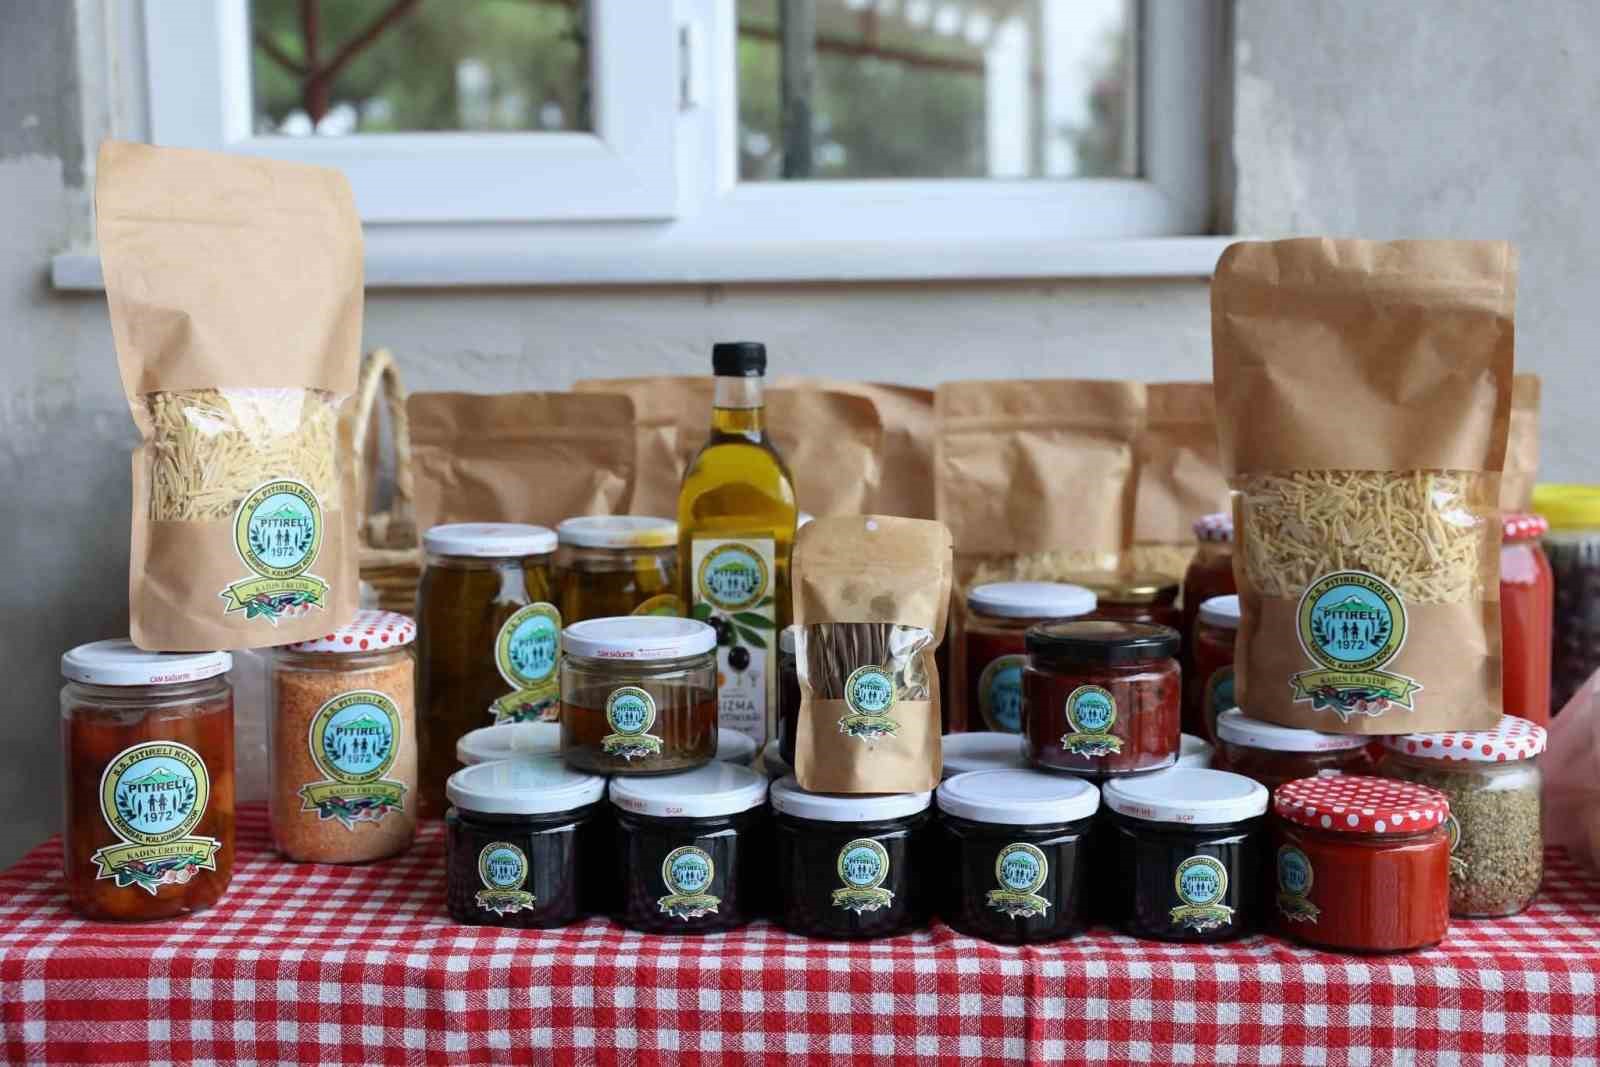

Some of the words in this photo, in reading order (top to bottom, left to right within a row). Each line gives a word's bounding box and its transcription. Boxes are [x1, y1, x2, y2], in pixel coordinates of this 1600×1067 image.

[271, 546, 295, 558] 1972
[1335, 640, 1366, 651] 1972
[347, 754, 372, 765] 1972
[144, 810, 174, 824] 1972
